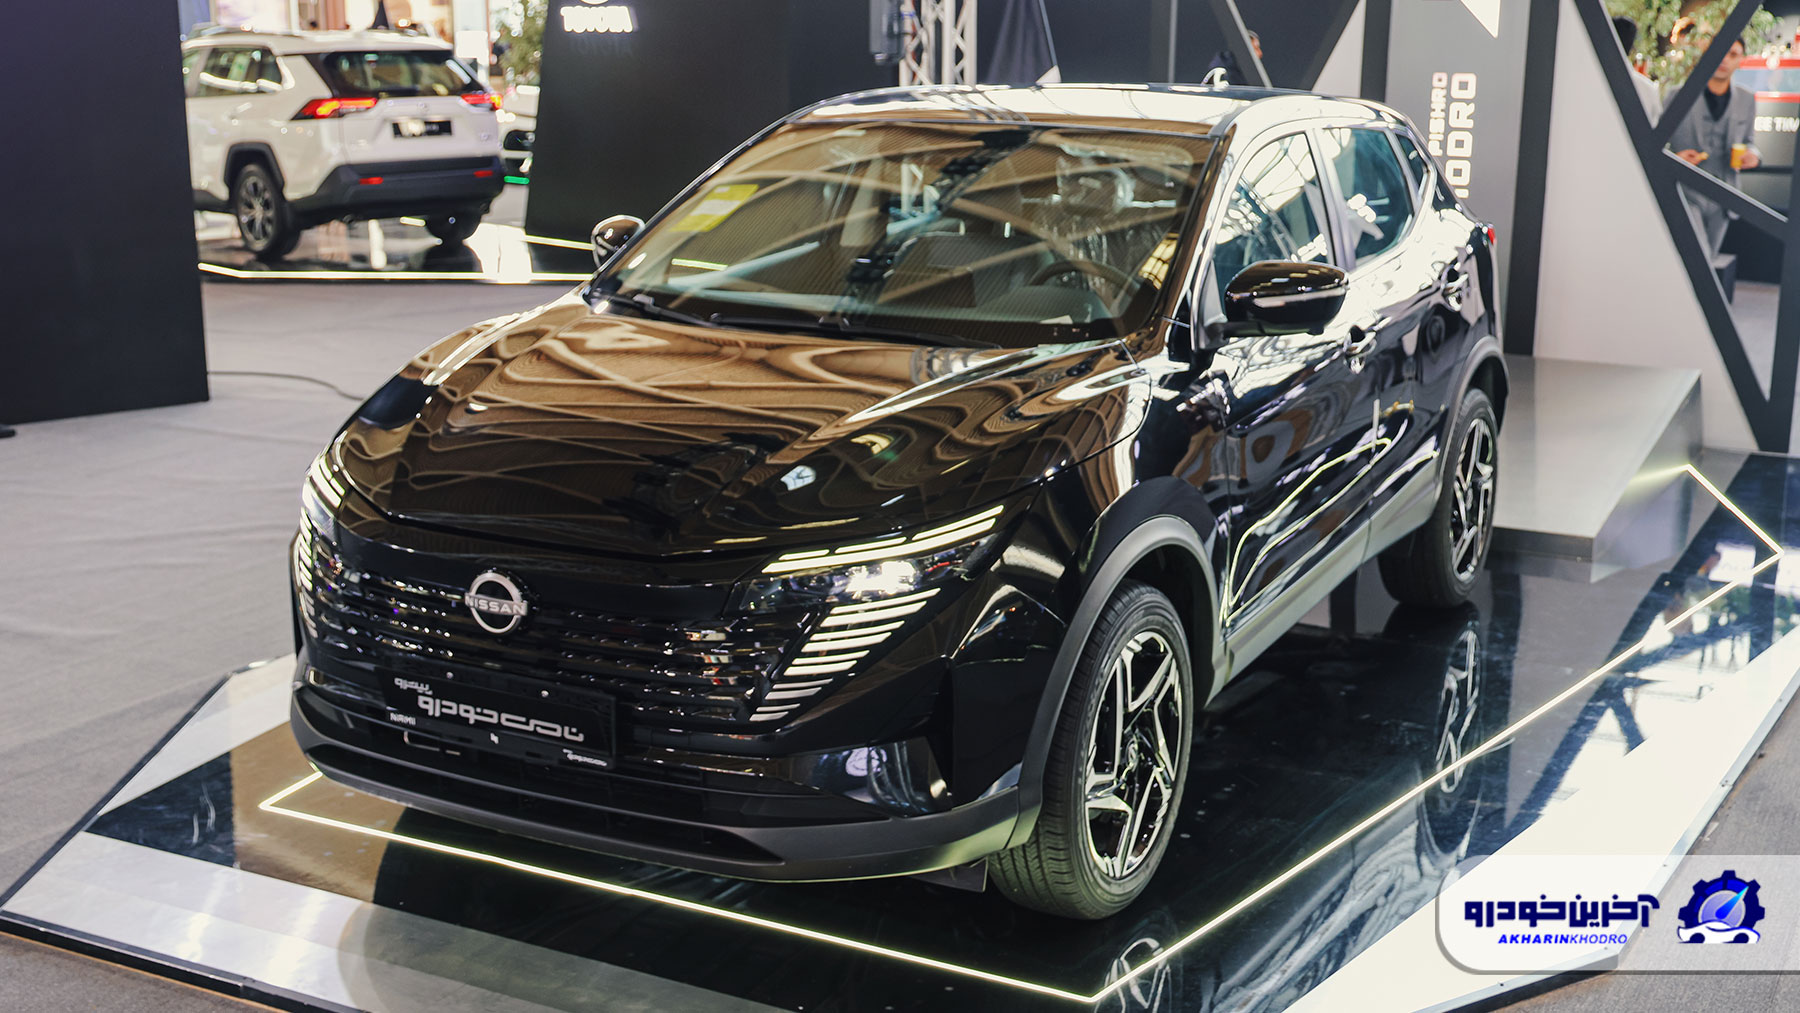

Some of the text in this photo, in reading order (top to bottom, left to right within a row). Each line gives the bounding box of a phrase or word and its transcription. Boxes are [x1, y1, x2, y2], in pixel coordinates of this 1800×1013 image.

[560, 6, 633, 33] TOYOTA
[1428, 72, 1448, 156] PISHRO
[465, 594, 527, 616] NISSAN
[417, 695, 499, 724] خودرو
